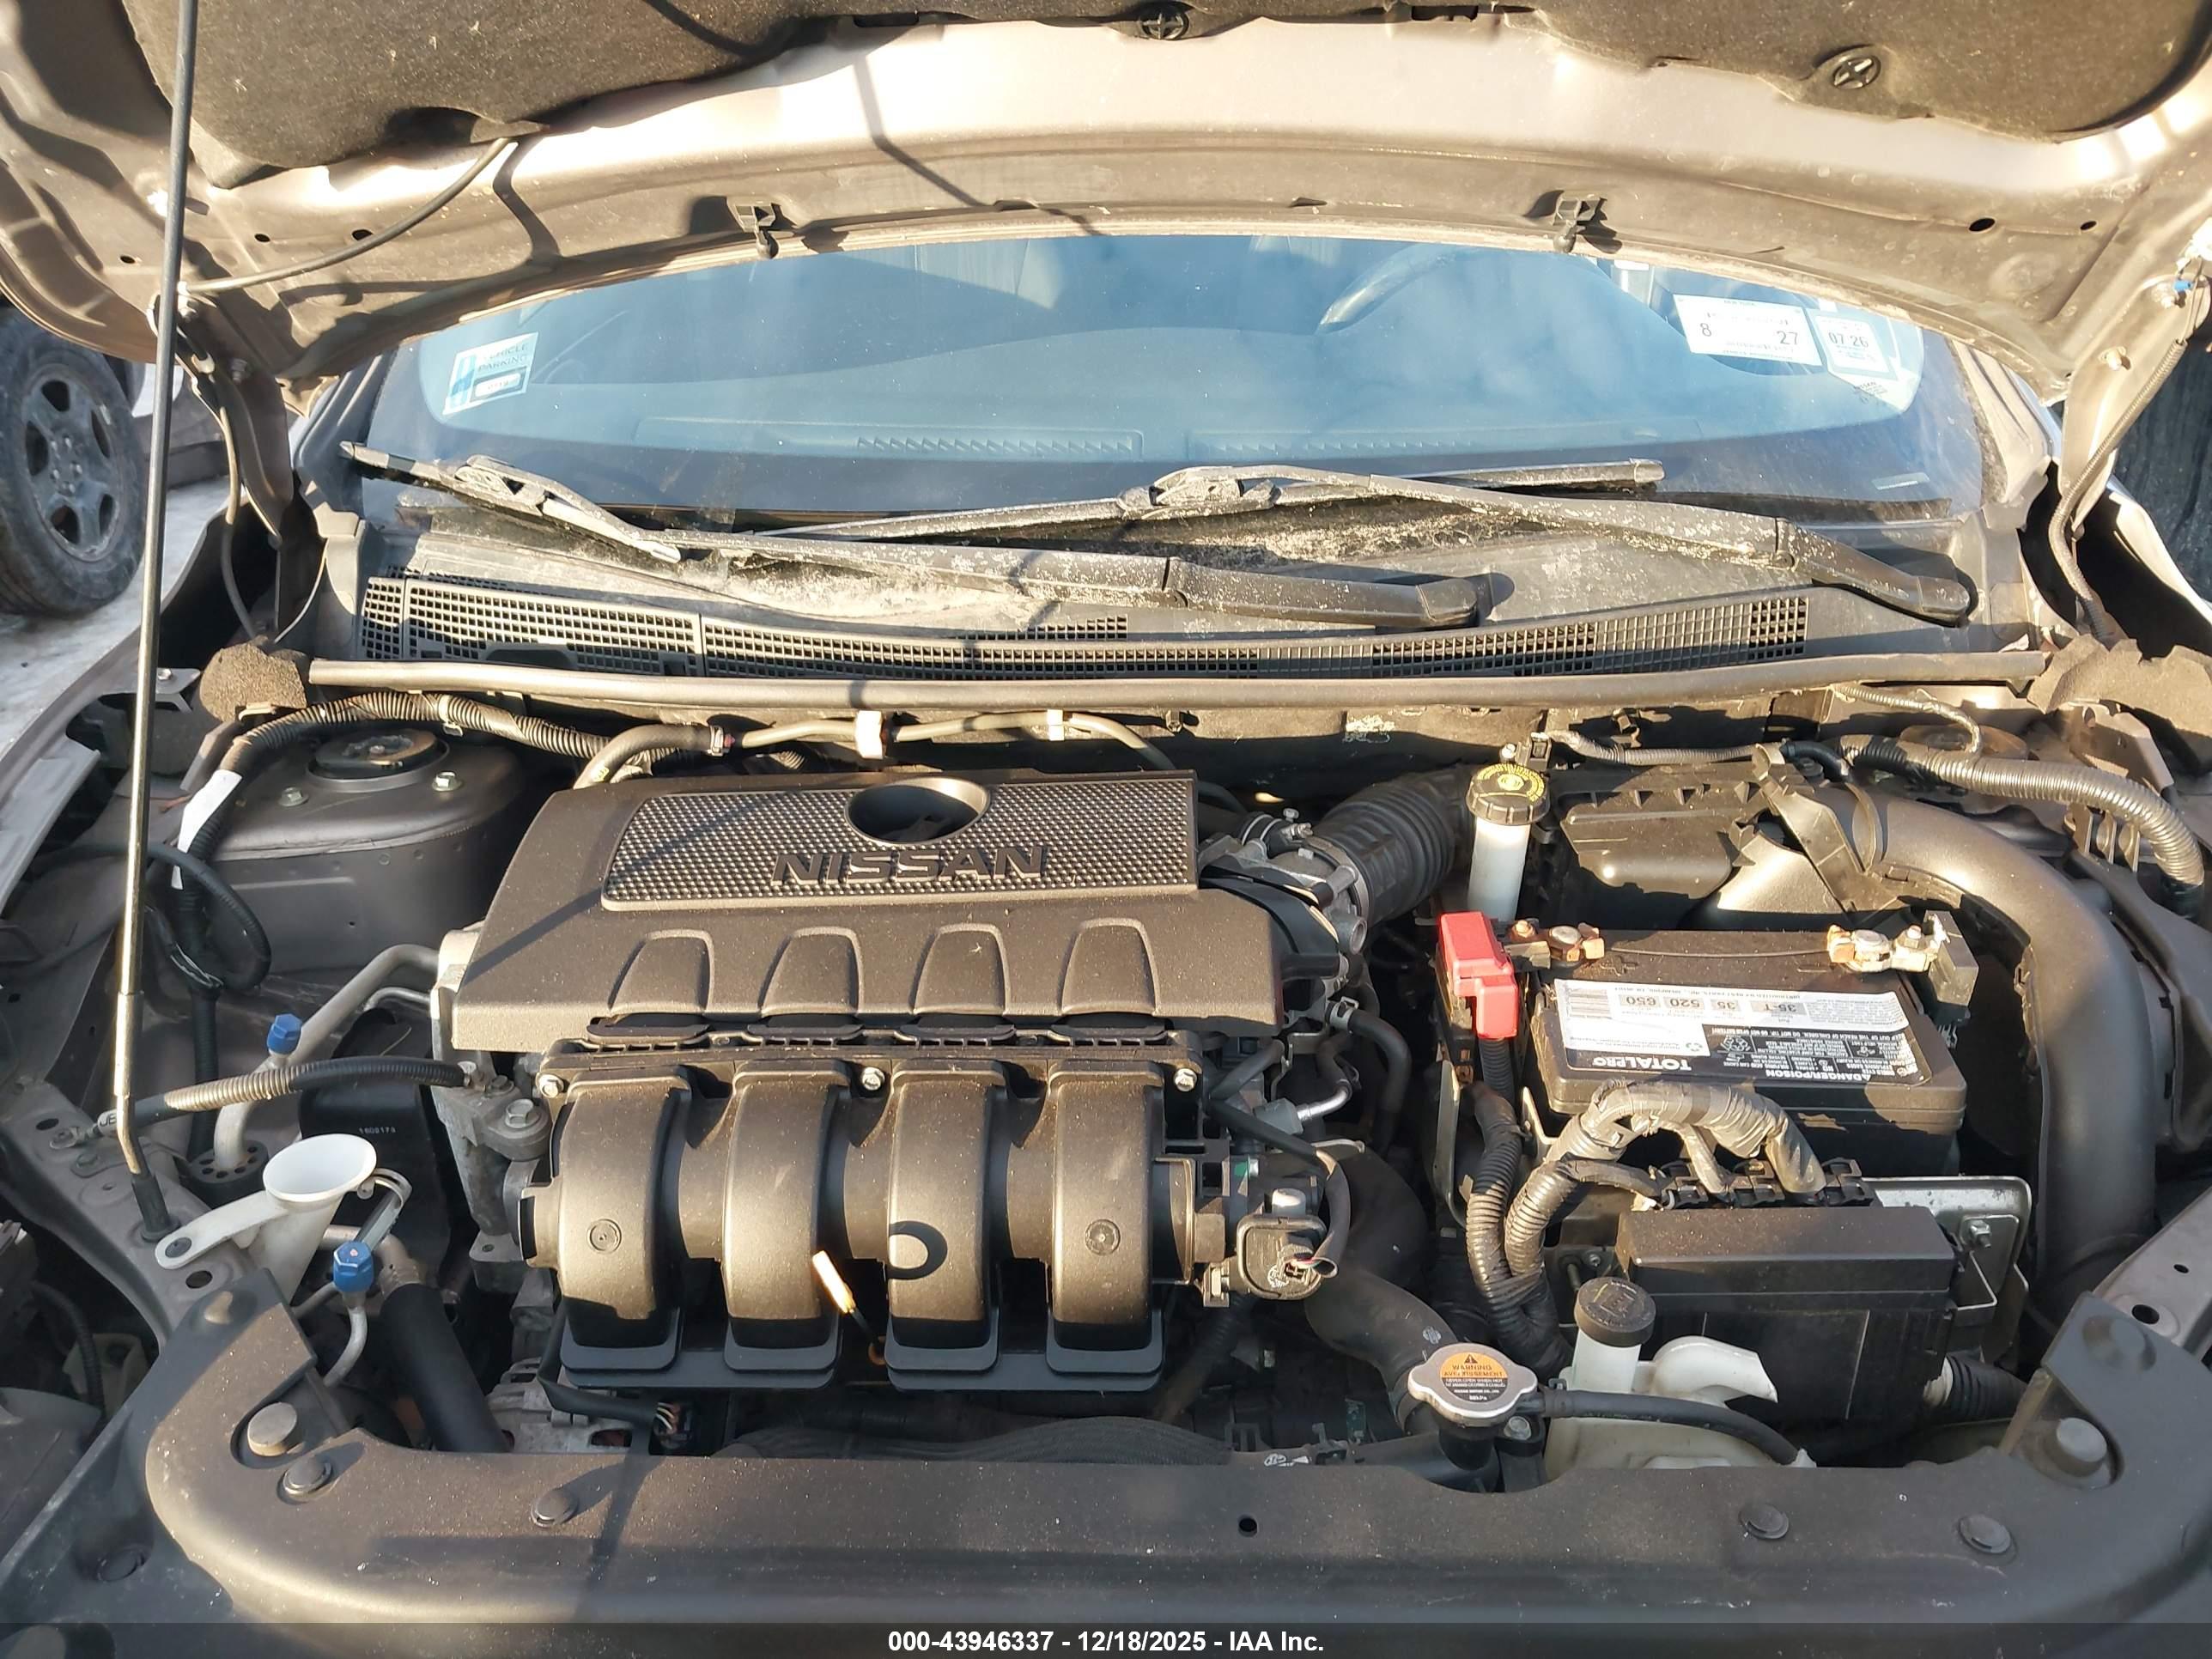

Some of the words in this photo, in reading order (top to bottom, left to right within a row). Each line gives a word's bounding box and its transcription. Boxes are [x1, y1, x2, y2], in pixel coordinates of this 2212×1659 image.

[1699, 322, 1712, 337] 8
[1776, 330, 1799, 346] 27
[1828, 331, 1847, 346] 07
[771, 847, 1044, 885] NISSAN
[1625, 995, 1656, 1006] 650
[1668, 997, 1700, 1007] 520
[1715, 1000, 1736, 1010] 35
